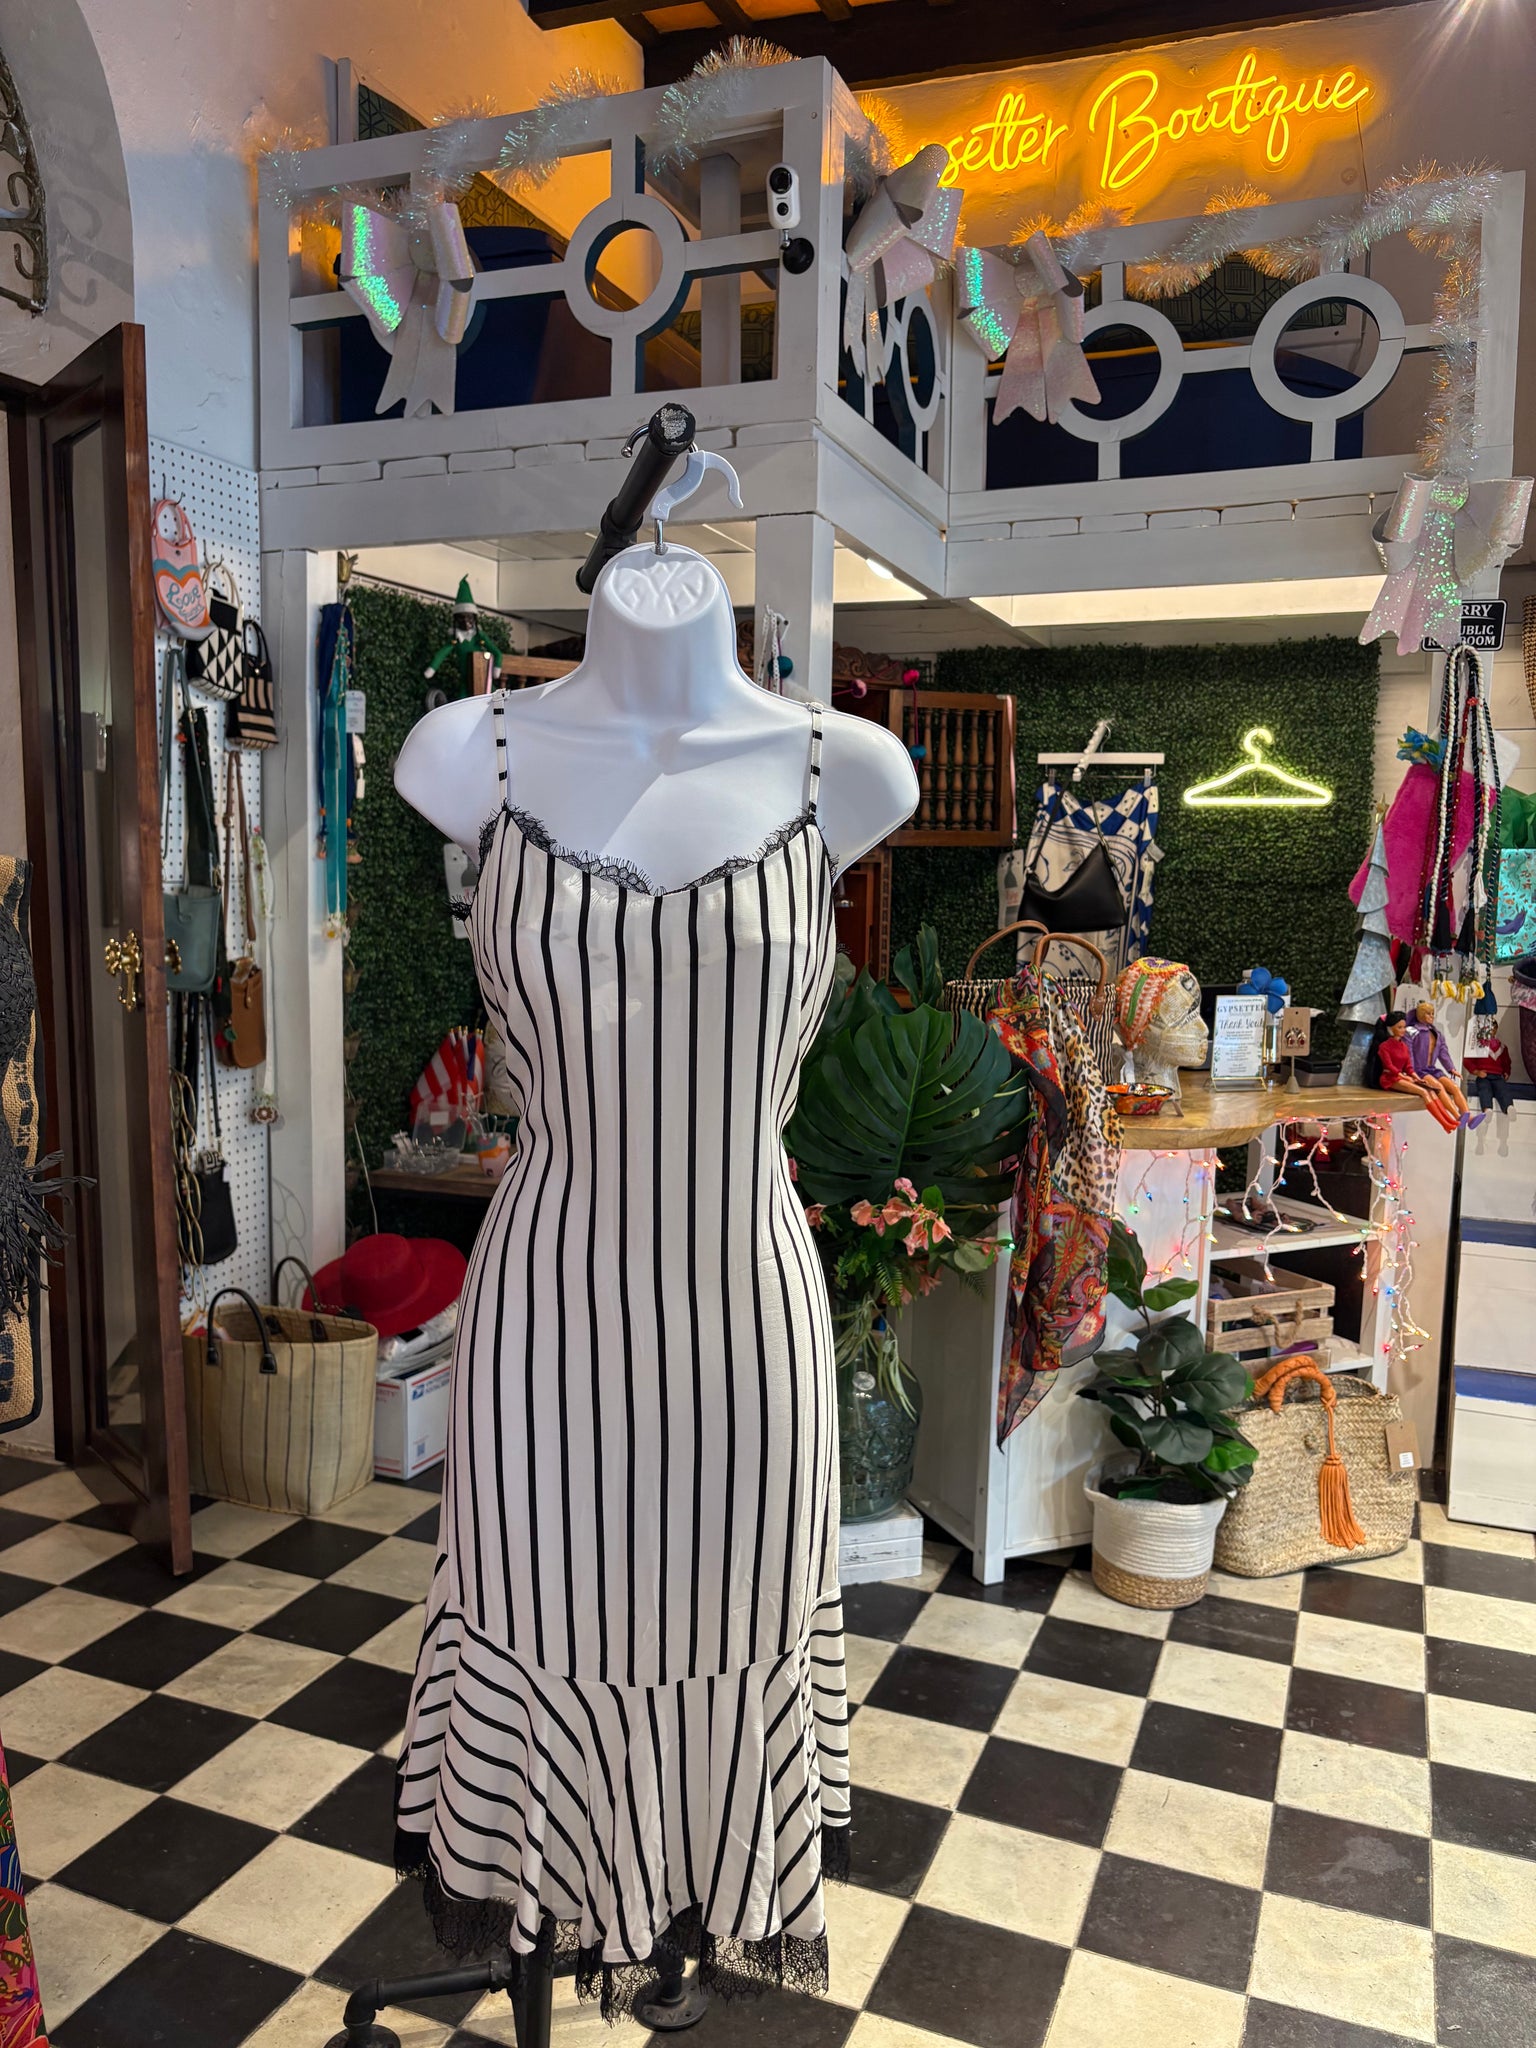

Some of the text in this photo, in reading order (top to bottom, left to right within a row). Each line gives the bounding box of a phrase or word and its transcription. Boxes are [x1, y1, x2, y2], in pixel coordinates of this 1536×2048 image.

[934, 51, 1371, 190] setter Boutique
[1461, 604, 1493, 616] RRY
[1461, 625, 1495, 635] UBLIC
